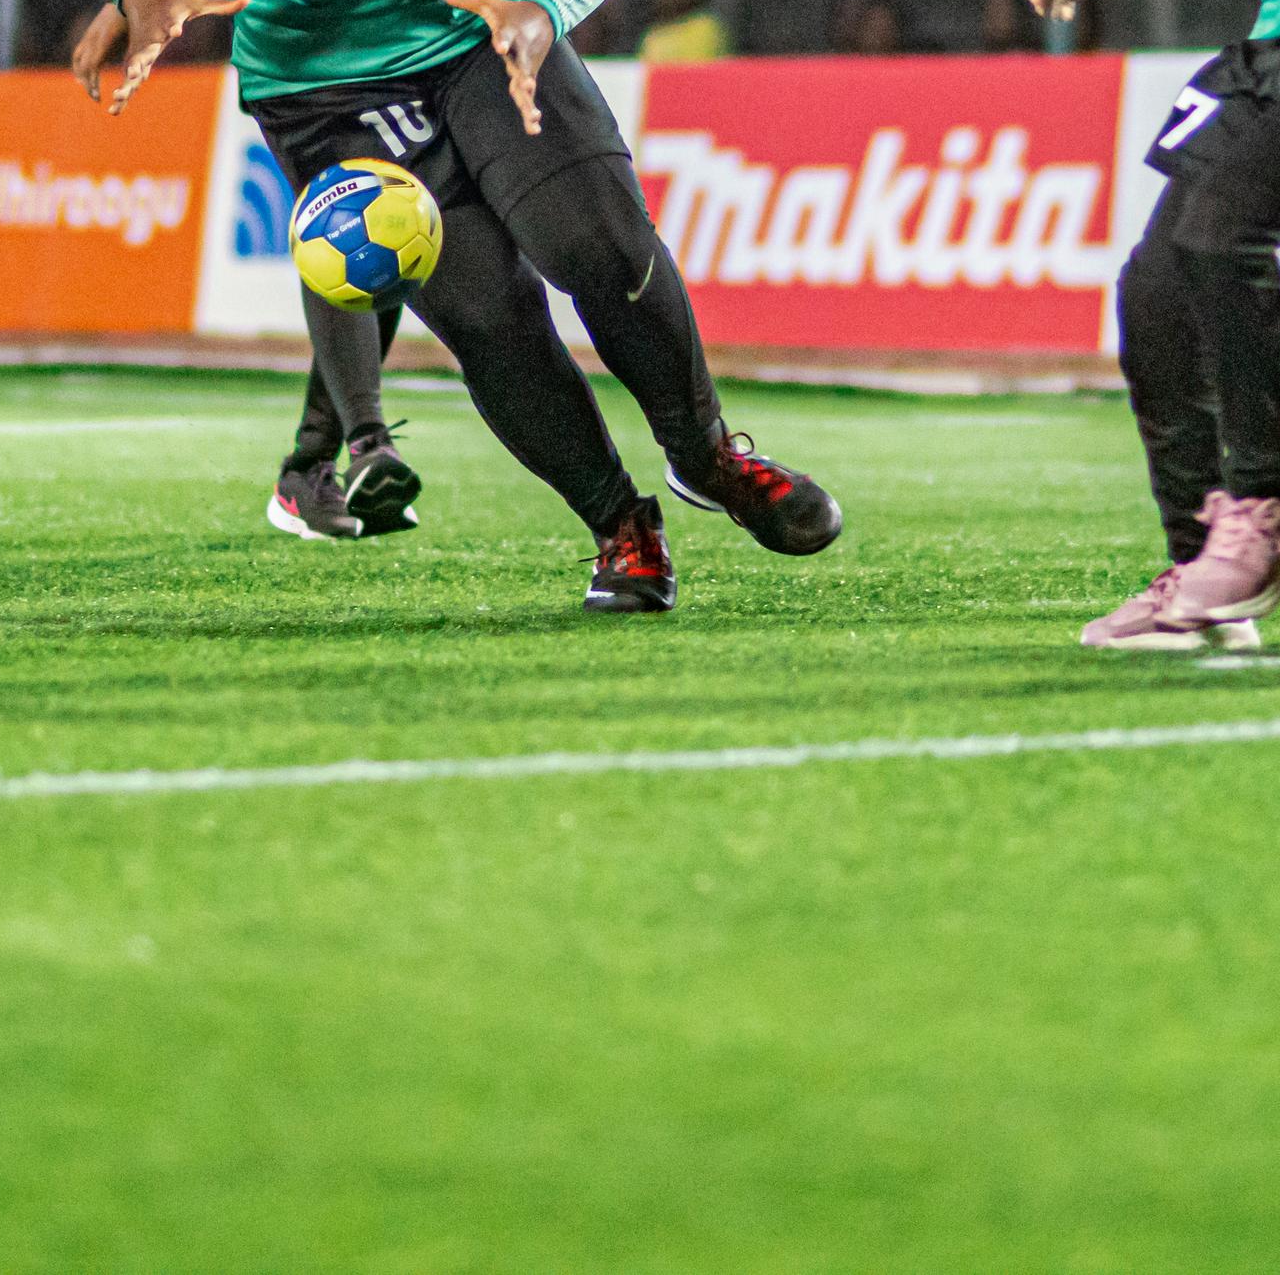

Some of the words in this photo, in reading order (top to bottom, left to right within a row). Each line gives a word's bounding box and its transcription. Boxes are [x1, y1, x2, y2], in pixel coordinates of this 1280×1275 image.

[359, 99, 434, 158] 10
[1158, 85, 1220, 150] 7
[307, 181, 359, 218] samba
